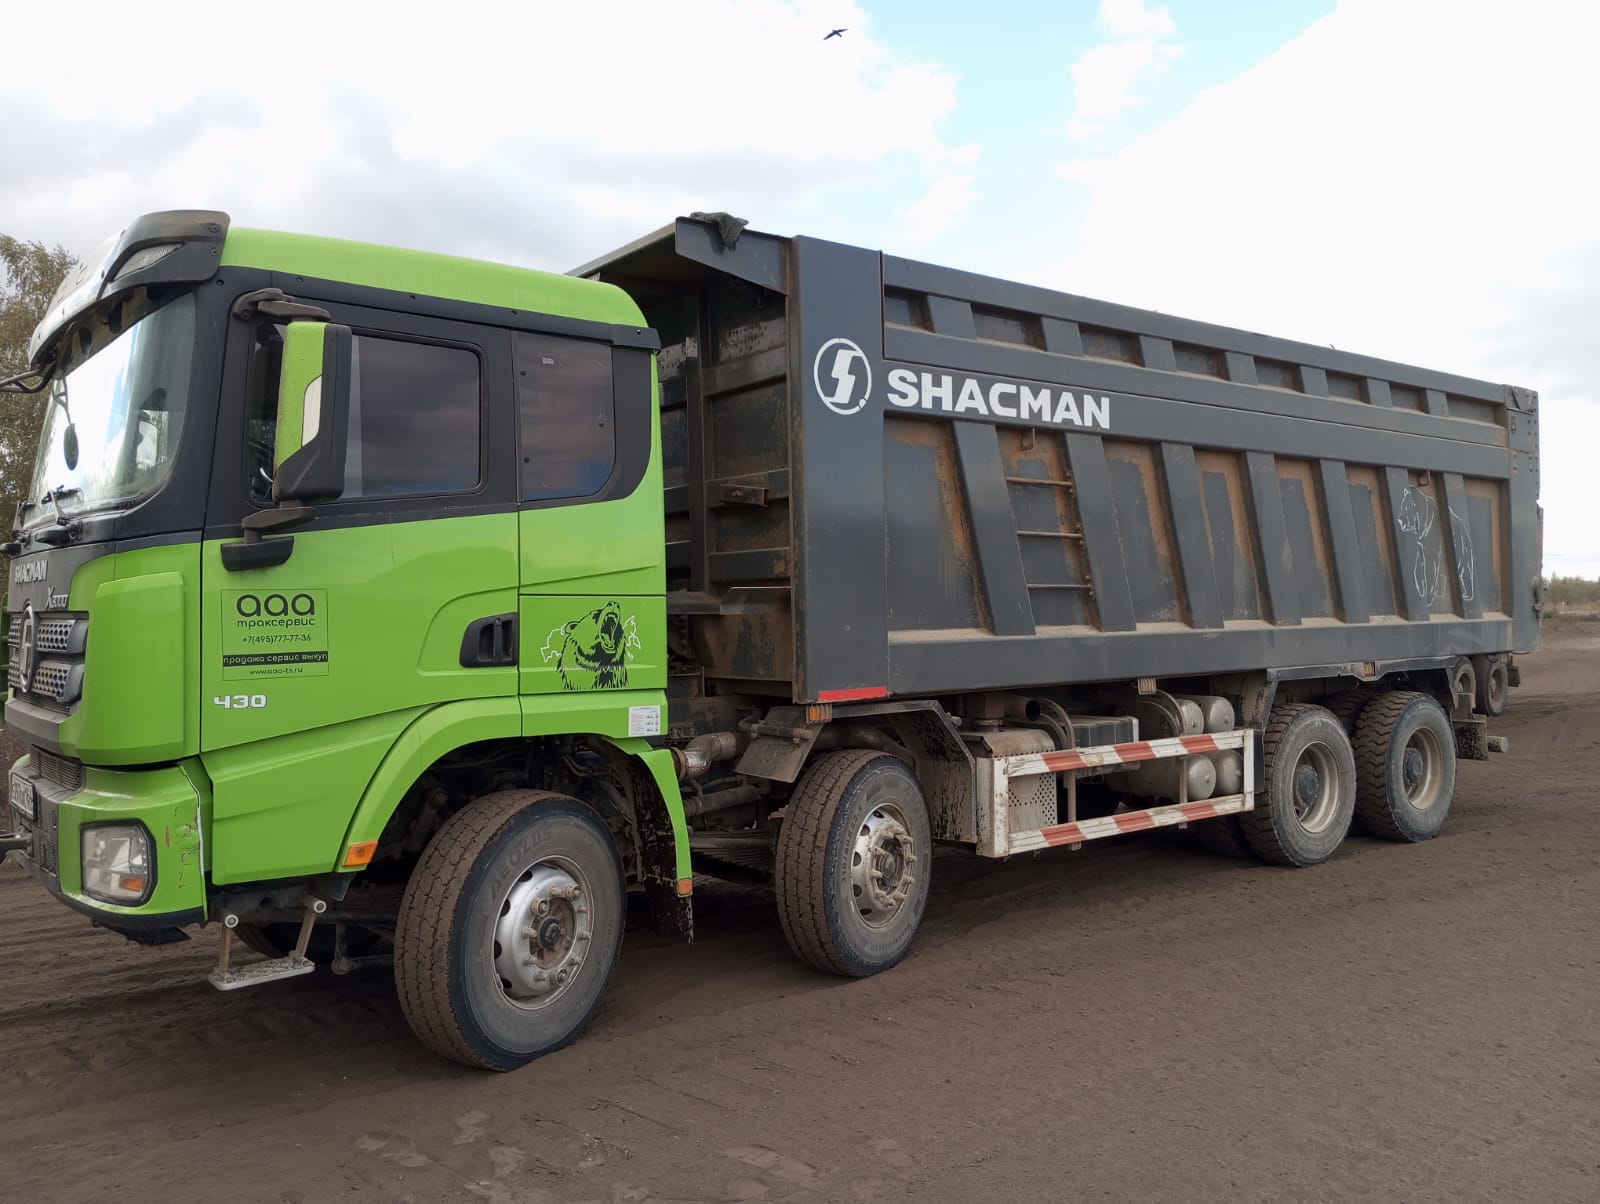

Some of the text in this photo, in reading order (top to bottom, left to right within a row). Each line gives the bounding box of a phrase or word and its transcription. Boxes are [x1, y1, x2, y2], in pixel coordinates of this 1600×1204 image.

[887, 368, 1111, 429] SHACMAN
[237, 618, 316, 630] траксервис
[243, 634, 311, 645] +7(495)777-77-36
[223, 653, 328, 665] продажа сервис выкуп
[249, 667, 303, 676] www.aaa-ts.ru
[213, 694, 267, 709] 430
